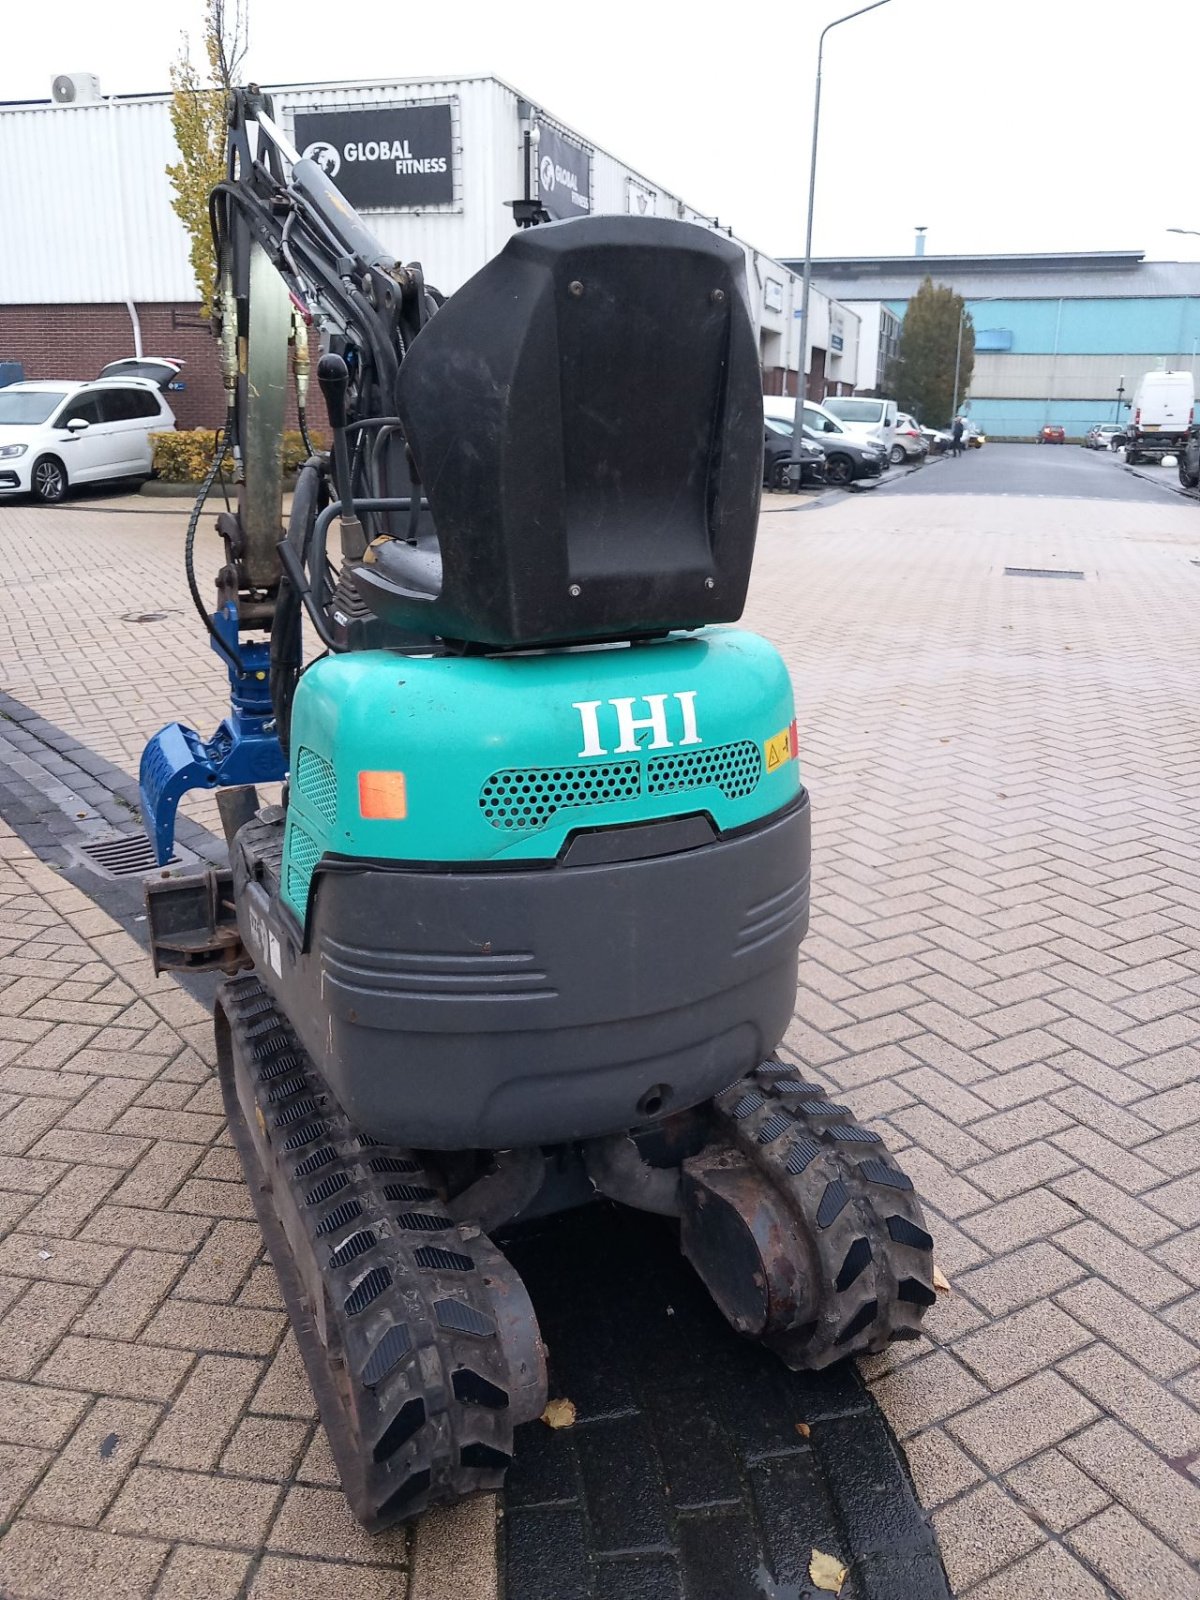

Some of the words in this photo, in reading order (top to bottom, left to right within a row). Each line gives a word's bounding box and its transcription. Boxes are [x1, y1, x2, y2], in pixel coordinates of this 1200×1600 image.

[343, 140, 413, 162] GLOBAL
[395, 157, 447, 175] FITNESS
[571, 690, 703, 758] IHI
